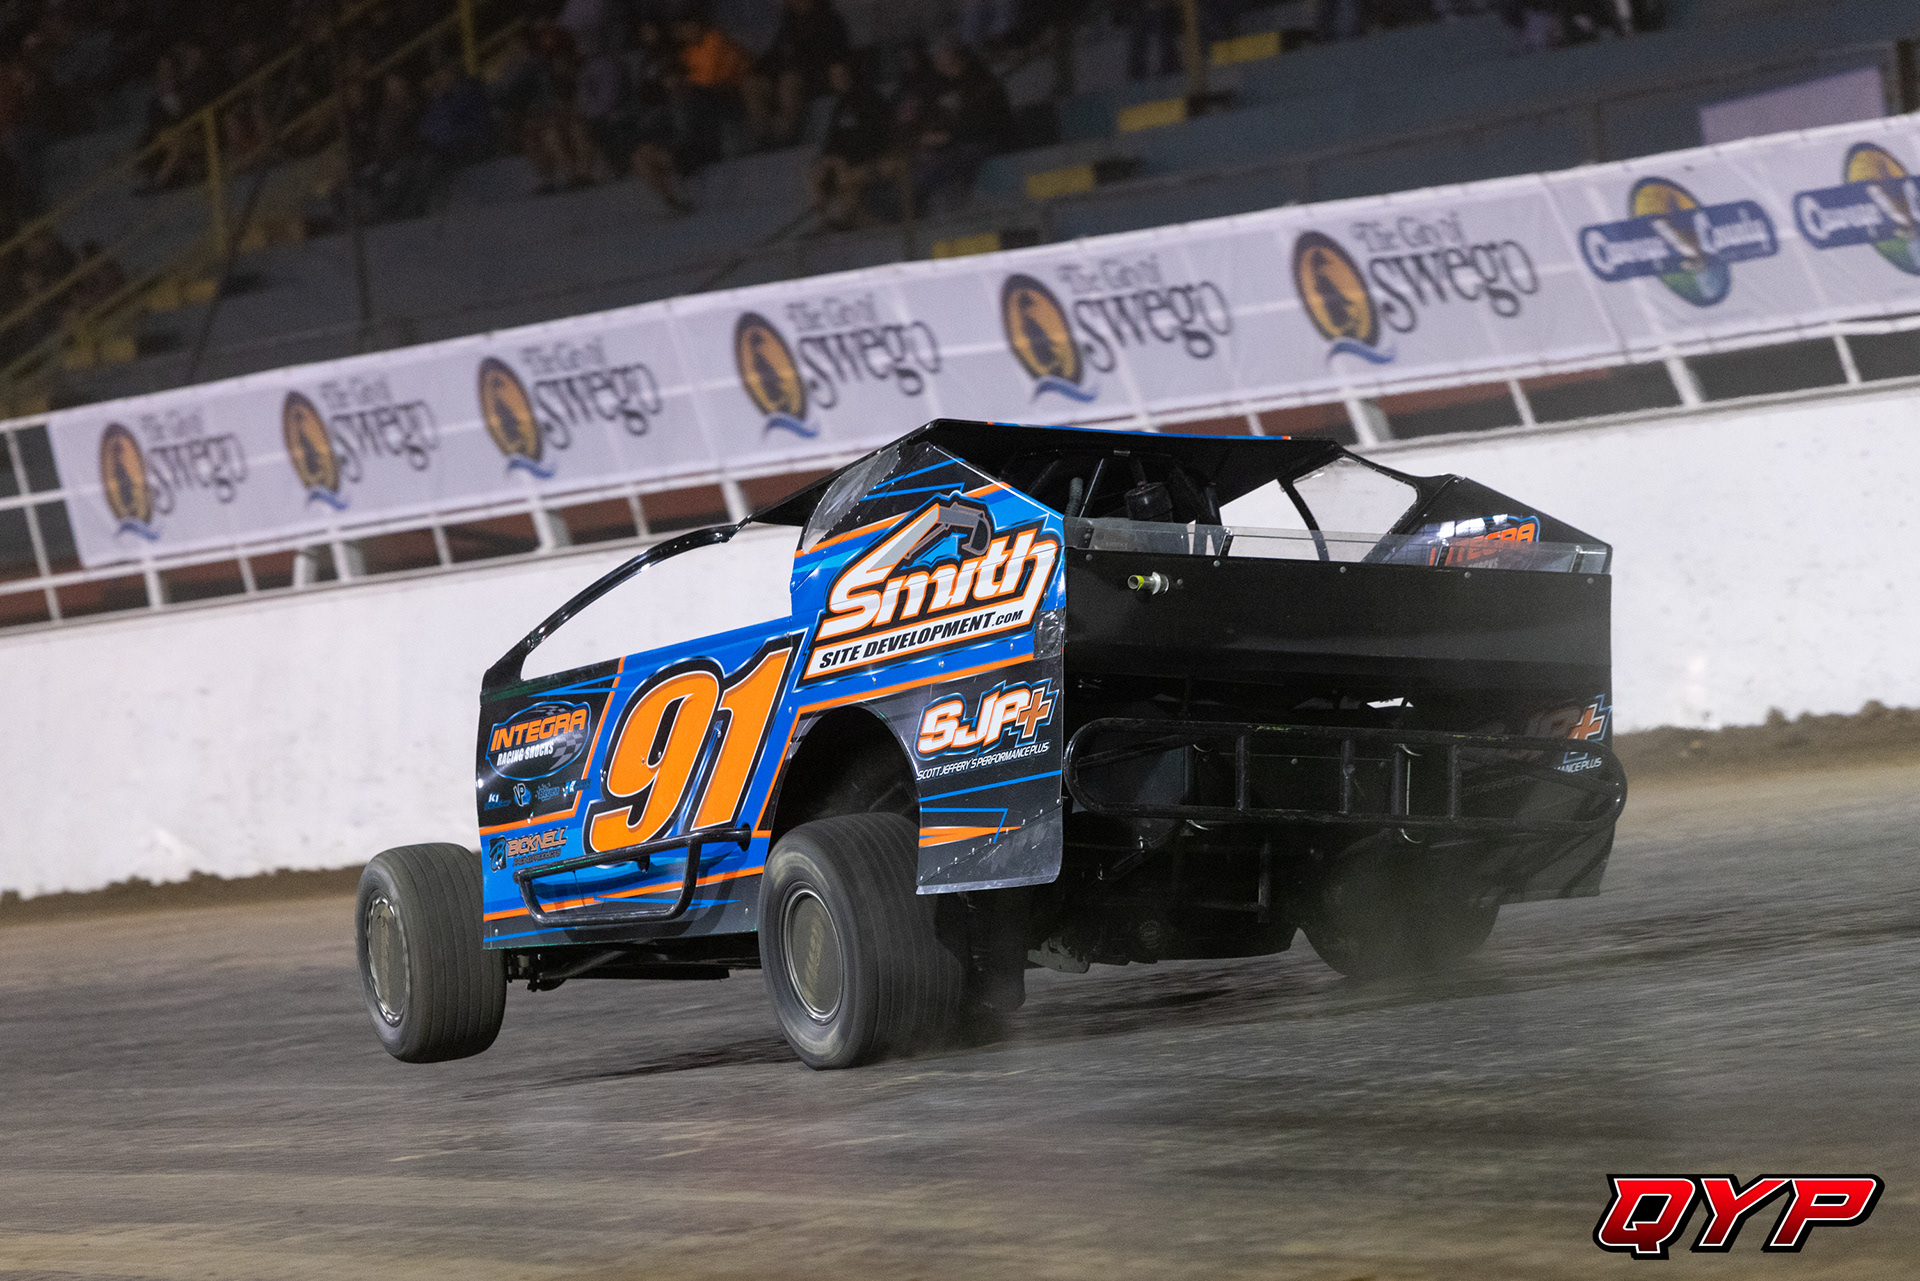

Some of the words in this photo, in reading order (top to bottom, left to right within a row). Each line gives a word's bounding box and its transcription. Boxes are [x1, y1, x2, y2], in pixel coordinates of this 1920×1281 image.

[815, 503, 1058, 641] Smith
[819, 644, 859, 669] SITE
[490, 708, 587, 752] INTEGRA
[497, 748, 525, 766] RACING
[525, 742, 555, 760] SHOCKS
[591, 649, 793, 852] 91
[507, 827, 568, 857] BICKNELL
